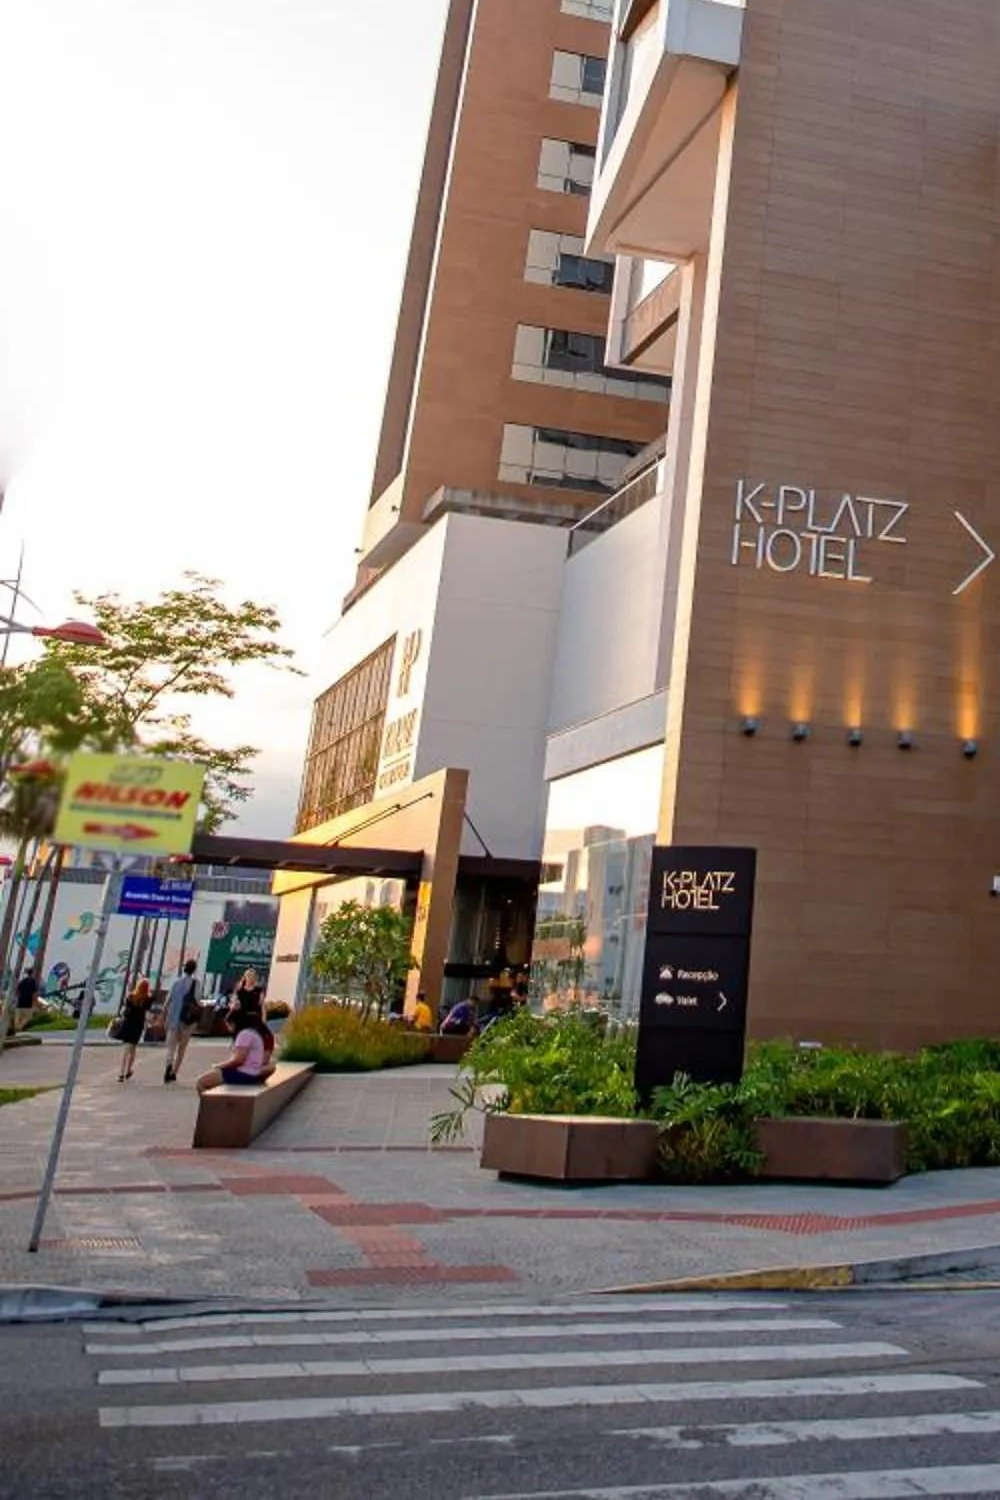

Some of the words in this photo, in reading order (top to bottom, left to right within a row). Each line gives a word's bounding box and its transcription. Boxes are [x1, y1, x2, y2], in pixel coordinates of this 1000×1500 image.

[735, 479, 909, 543] K-PLATZ
[731, 522, 873, 582] HOTEL
[662, 870, 736, 892] K-PLATZ
[661, 888, 719, 909] HOTEL
[676, 995, 698, 1006] Valet
